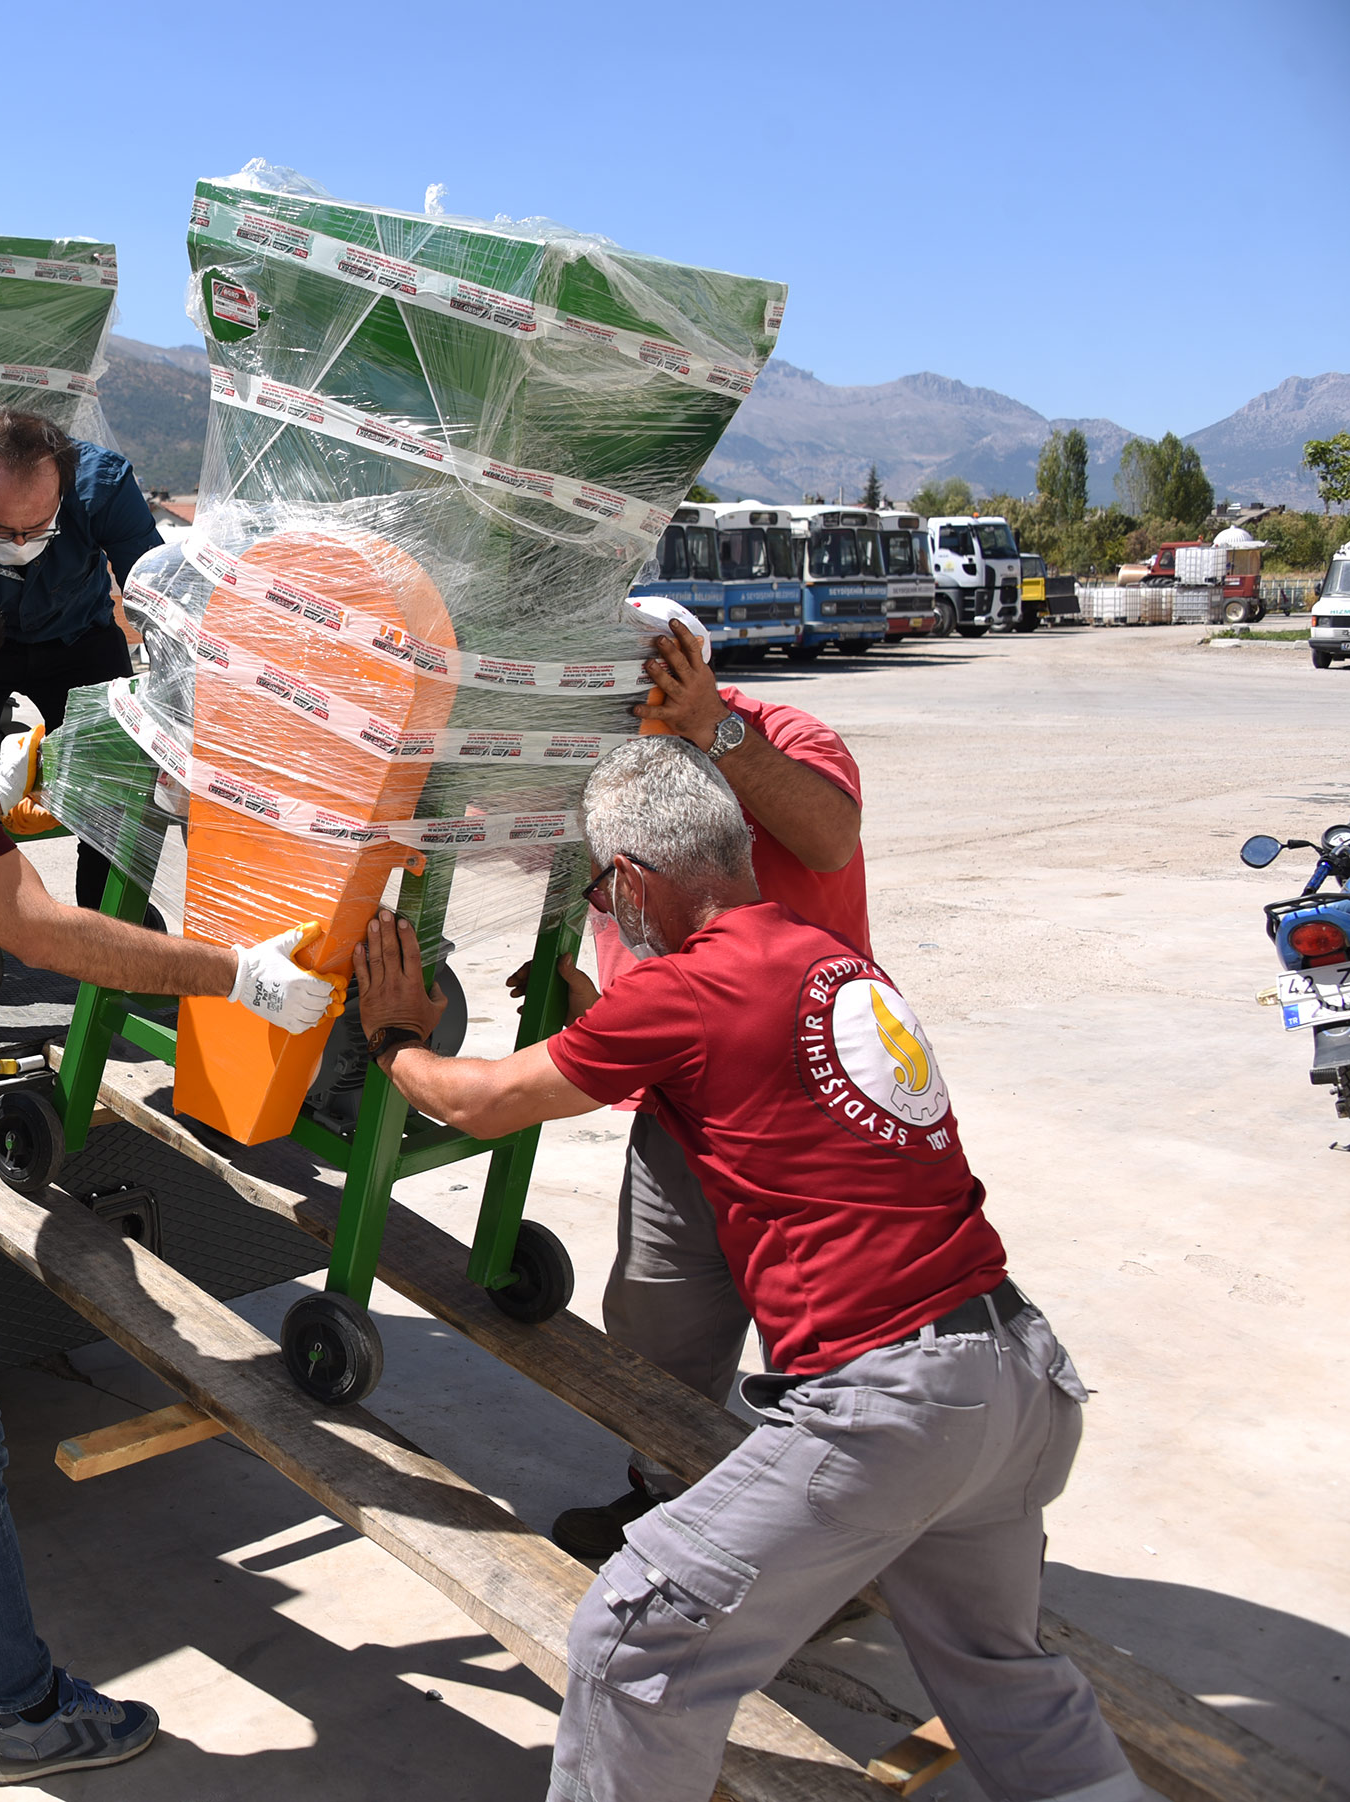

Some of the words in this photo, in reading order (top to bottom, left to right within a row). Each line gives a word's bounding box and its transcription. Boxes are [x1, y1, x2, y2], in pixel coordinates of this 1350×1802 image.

[1288, 976, 1316, 994] 42
[1287, 1017, 1299, 1025] TR
[800, 1014, 909, 1146] SEYDİŞEHİR
[926, 1128, 951, 1151] 1871
